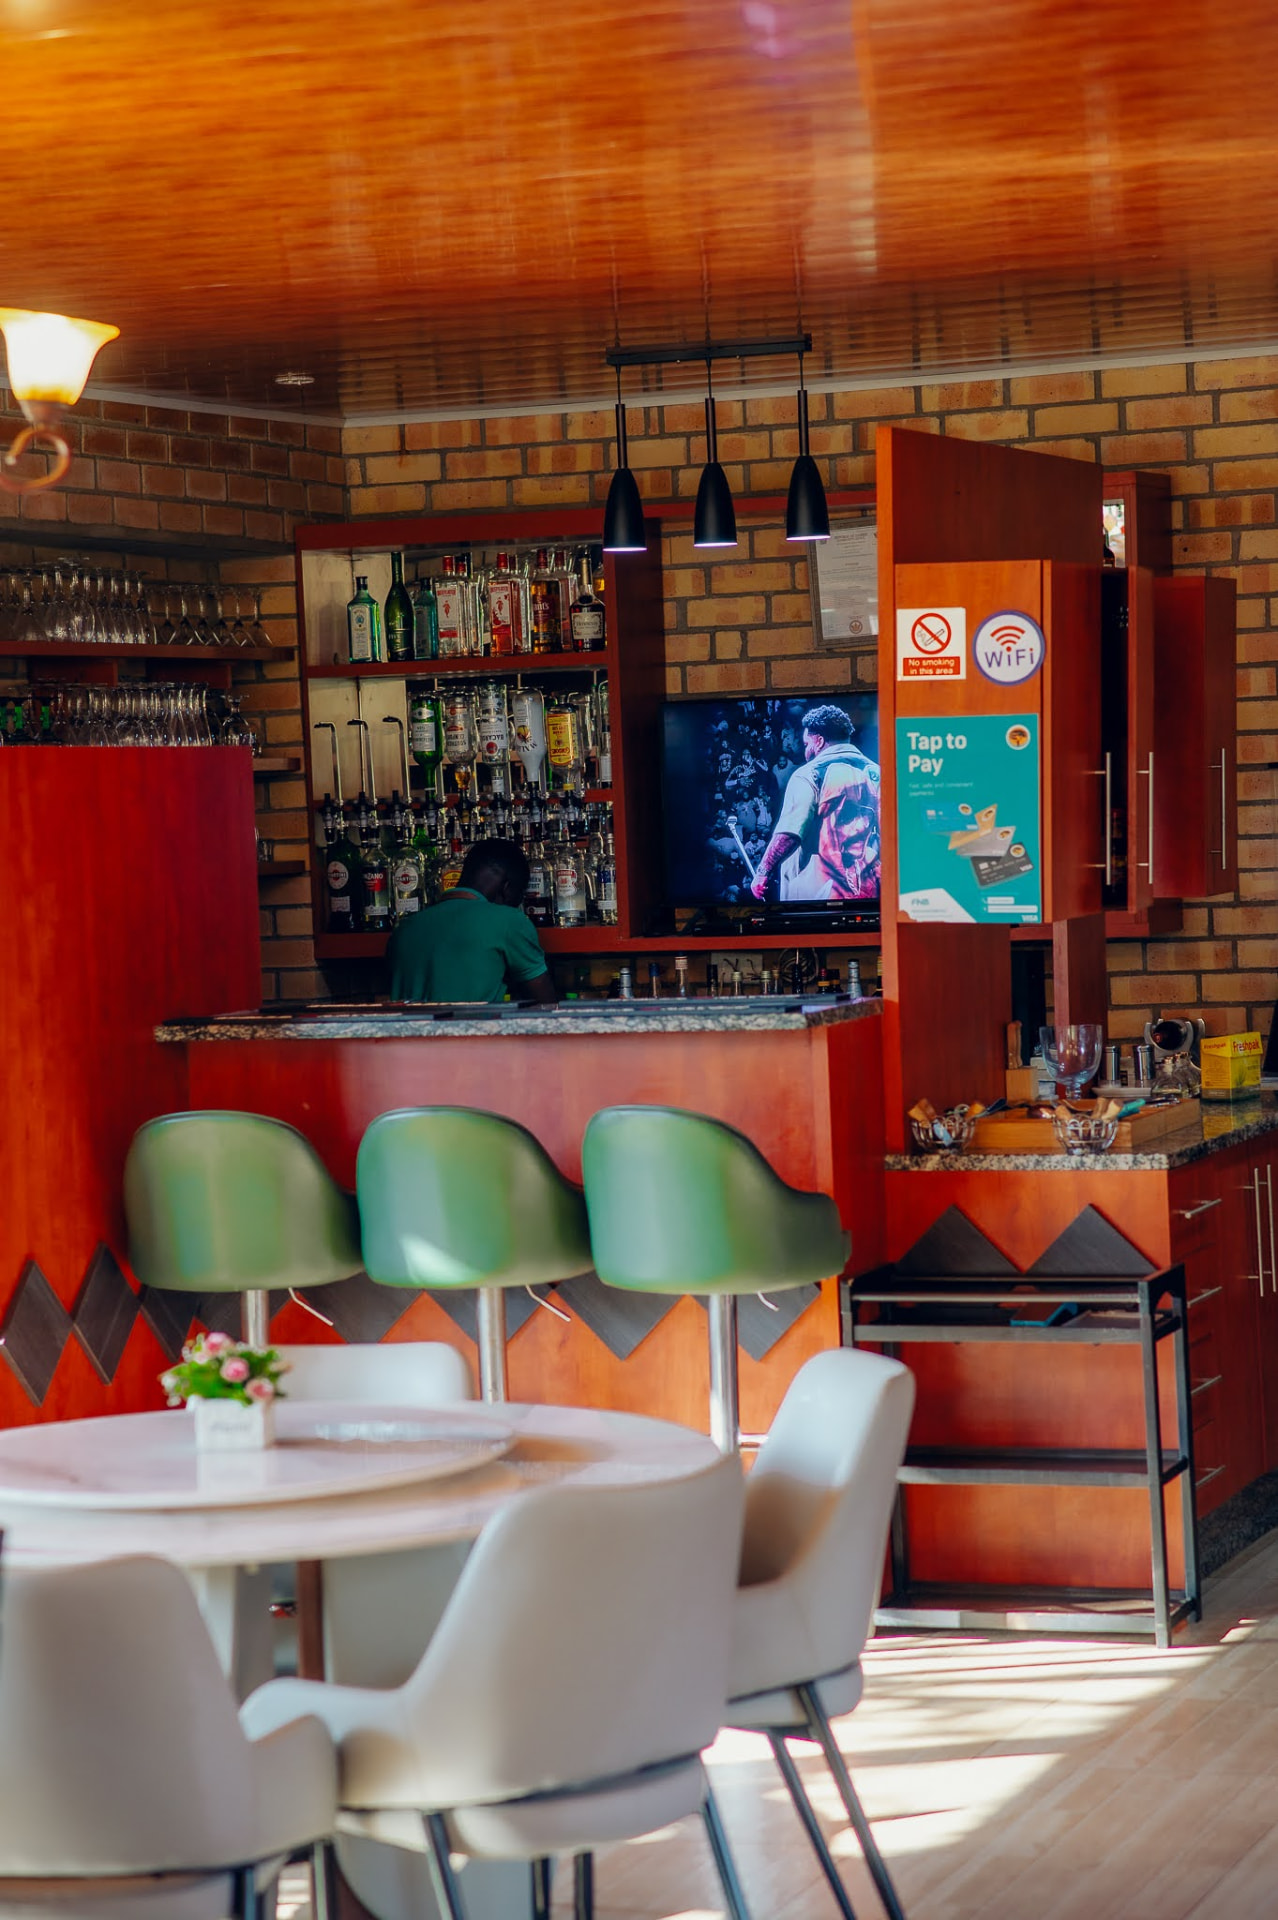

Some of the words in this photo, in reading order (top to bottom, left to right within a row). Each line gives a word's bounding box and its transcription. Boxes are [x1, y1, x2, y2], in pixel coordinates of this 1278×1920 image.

[908, 659, 920, 667] No
[922, 658, 955, 667] smoking
[907, 732, 943, 755] Tap
[946, 733, 967, 749] to
[909, 755, 943, 776] Pay
[1233, 1039, 1260, 1053] Freshpak
